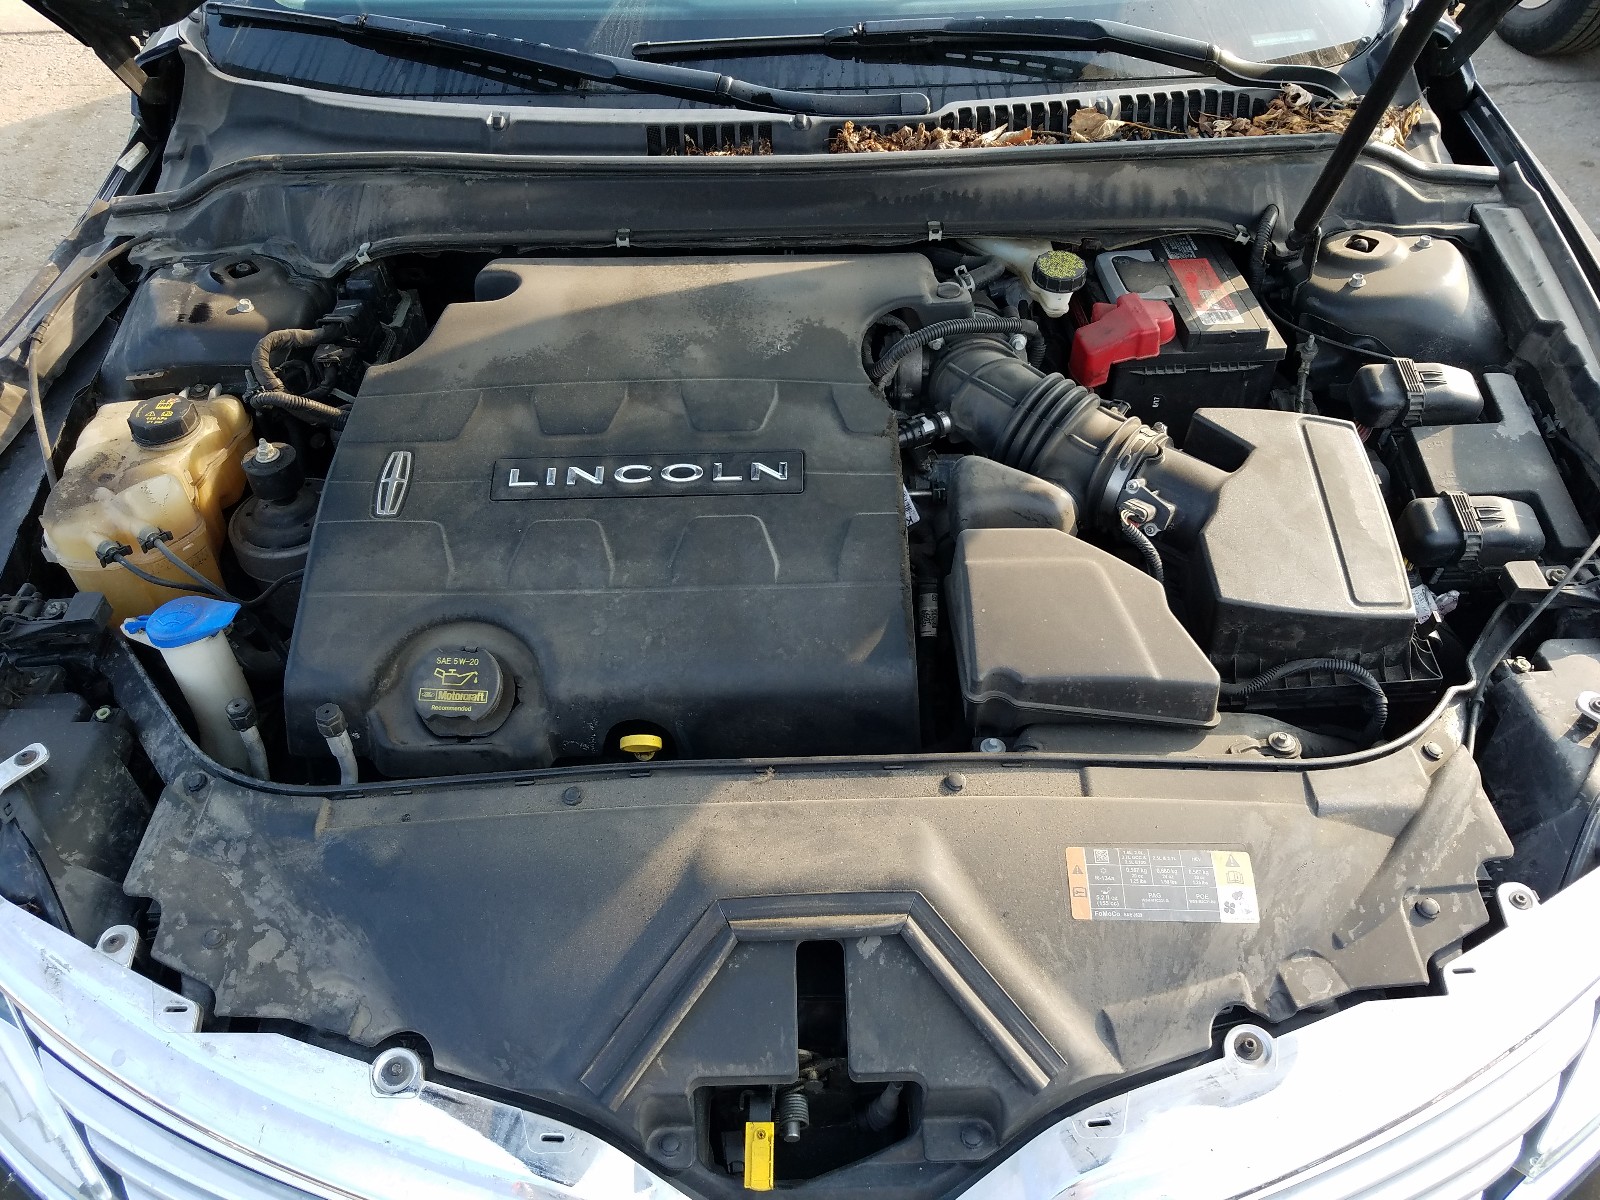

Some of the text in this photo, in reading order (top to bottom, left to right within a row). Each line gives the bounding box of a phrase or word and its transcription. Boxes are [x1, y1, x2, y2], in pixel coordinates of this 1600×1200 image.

[508, 461, 788, 487] LINCOLN
[436, 657, 479, 666] SAE 5W-20
[437, 690, 486, 702] Motorcraft
[431, 704, 472, 712] Recommended
